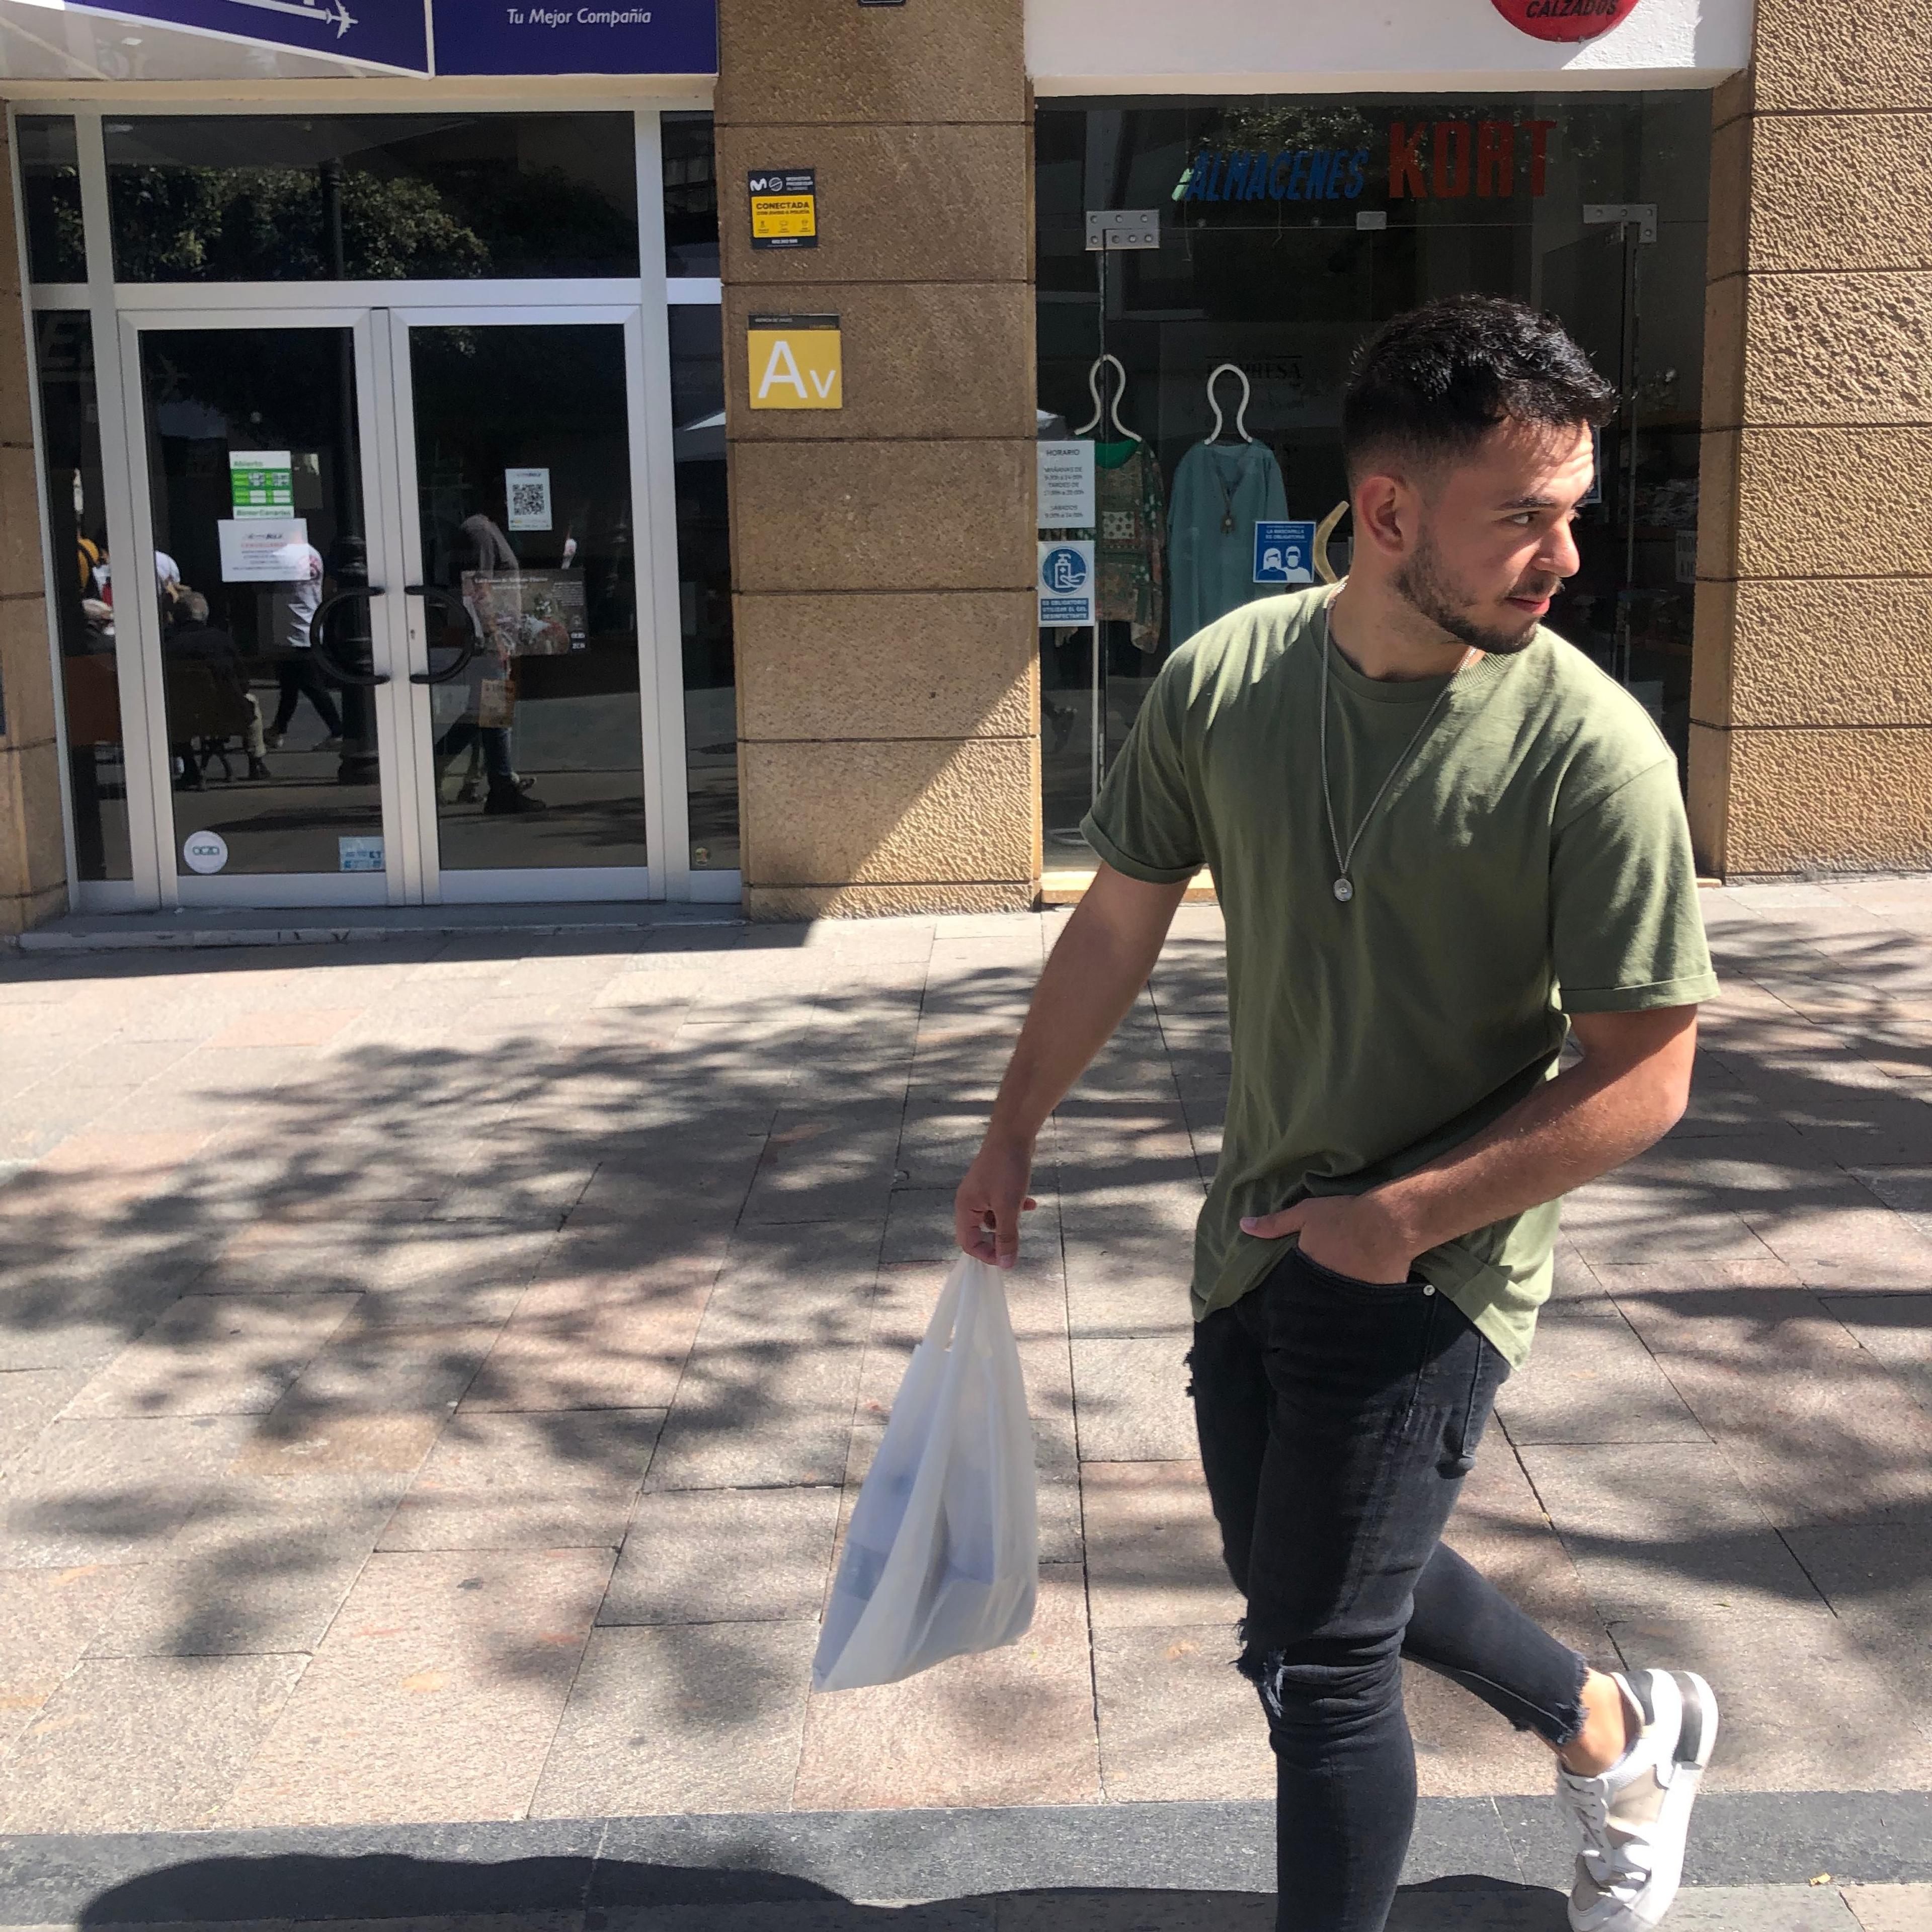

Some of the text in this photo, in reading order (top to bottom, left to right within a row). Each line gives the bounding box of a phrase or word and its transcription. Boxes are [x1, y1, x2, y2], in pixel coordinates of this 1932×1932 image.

[507, 8, 652, 28] Tu Mejor Compañía
[1526, 0, 1617, 18] CALZADOS
[1185, 121, 1558, 201] ALMACENES KORT
[756, 202, 810, 210] CONECTADA
[758, 340, 837, 399] Av
